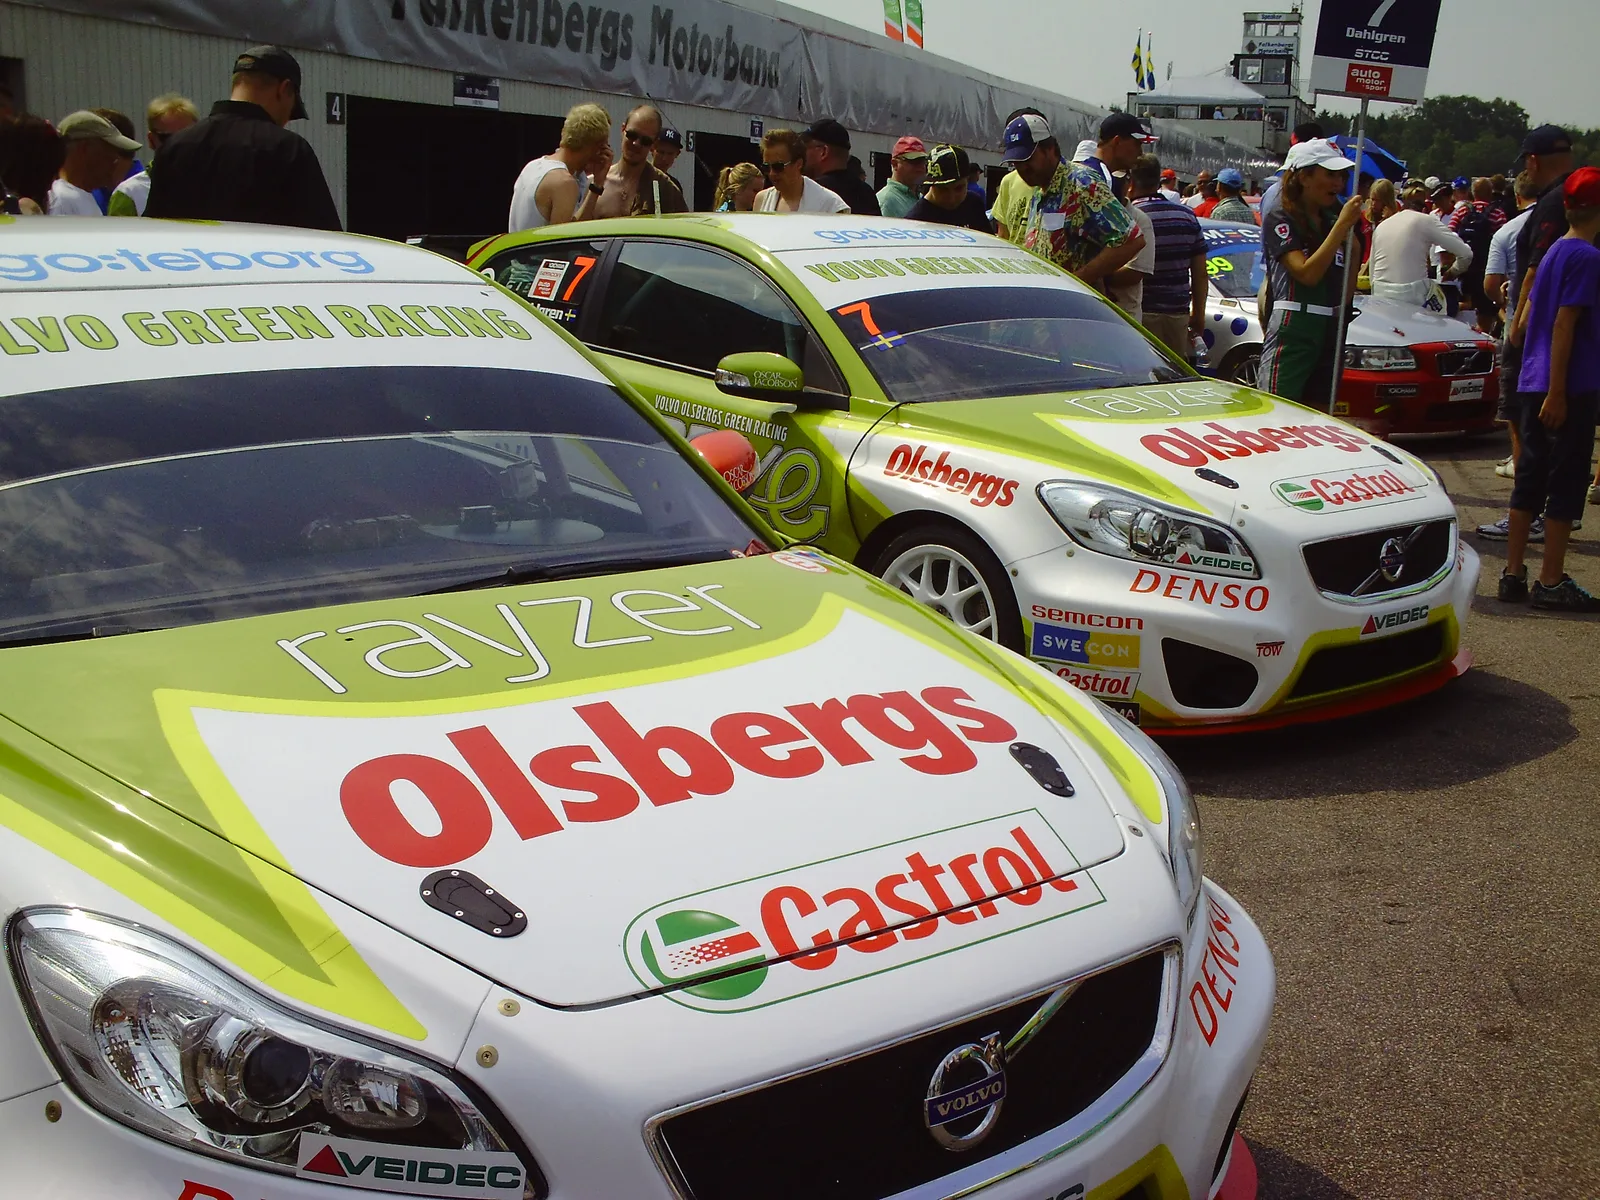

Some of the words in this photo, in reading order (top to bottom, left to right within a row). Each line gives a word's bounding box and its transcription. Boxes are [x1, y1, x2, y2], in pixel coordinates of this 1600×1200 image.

[649, 4, 780, 89] Motorbana
[1345, 26, 1406, 44] Dahlgren
[1354, 48, 1390, 61] STCC
[1350, 68, 1381, 79] auto
[1355, 77, 1385, 86] motor
[1364, 84, 1387, 92] sport
[331, 95, 341, 121] 4
[687, 132, 694, 150] 5
[0, 248, 375, 282] go:teborg
[562, 256, 597, 302] 7
[804, 258, 906, 283] VOLVO
[895, 257, 988, 276] GREEN
[121, 305, 335, 347] GREEN
[323, 304, 533, 342] RACING
[836, 300, 881, 336] 7
[753, 370, 782, 380] OSCAR
[753, 377, 798, 389] JACOBSON
[654, 394, 681, 414] VOLVO
[680, 401, 723, 425] OLSBERGS
[724, 412, 752, 433] GREEN
[753, 419, 789, 442] RACING
[1064, 387, 1244, 418] rayzer
[1140, 422, 1371, 468] Olsbergs
[883, 443, 1020, 508] Olsbergs
[1309, 469, 1416, 506] Castrol
[1189, 553, 1253, 572] VEIDEC
[1129, 568, 1270, 612] DENSO
[1031, 604, 1144, 631] semcon
[1374, 605, 1429, 630] VEIDEC
[276, 584, 762, 695] rayzer
[1256, 645, 1283, 658] TOW
[340, 685, 1018, 868] Olsbergs
[760, 826, 1079, 971] Castrol
[1189, 894, 1241, 1048] DENSO
[936, 1080, 1003, 1117] VOLVO
[336, 1150, 522, 1190] VEIDEC
